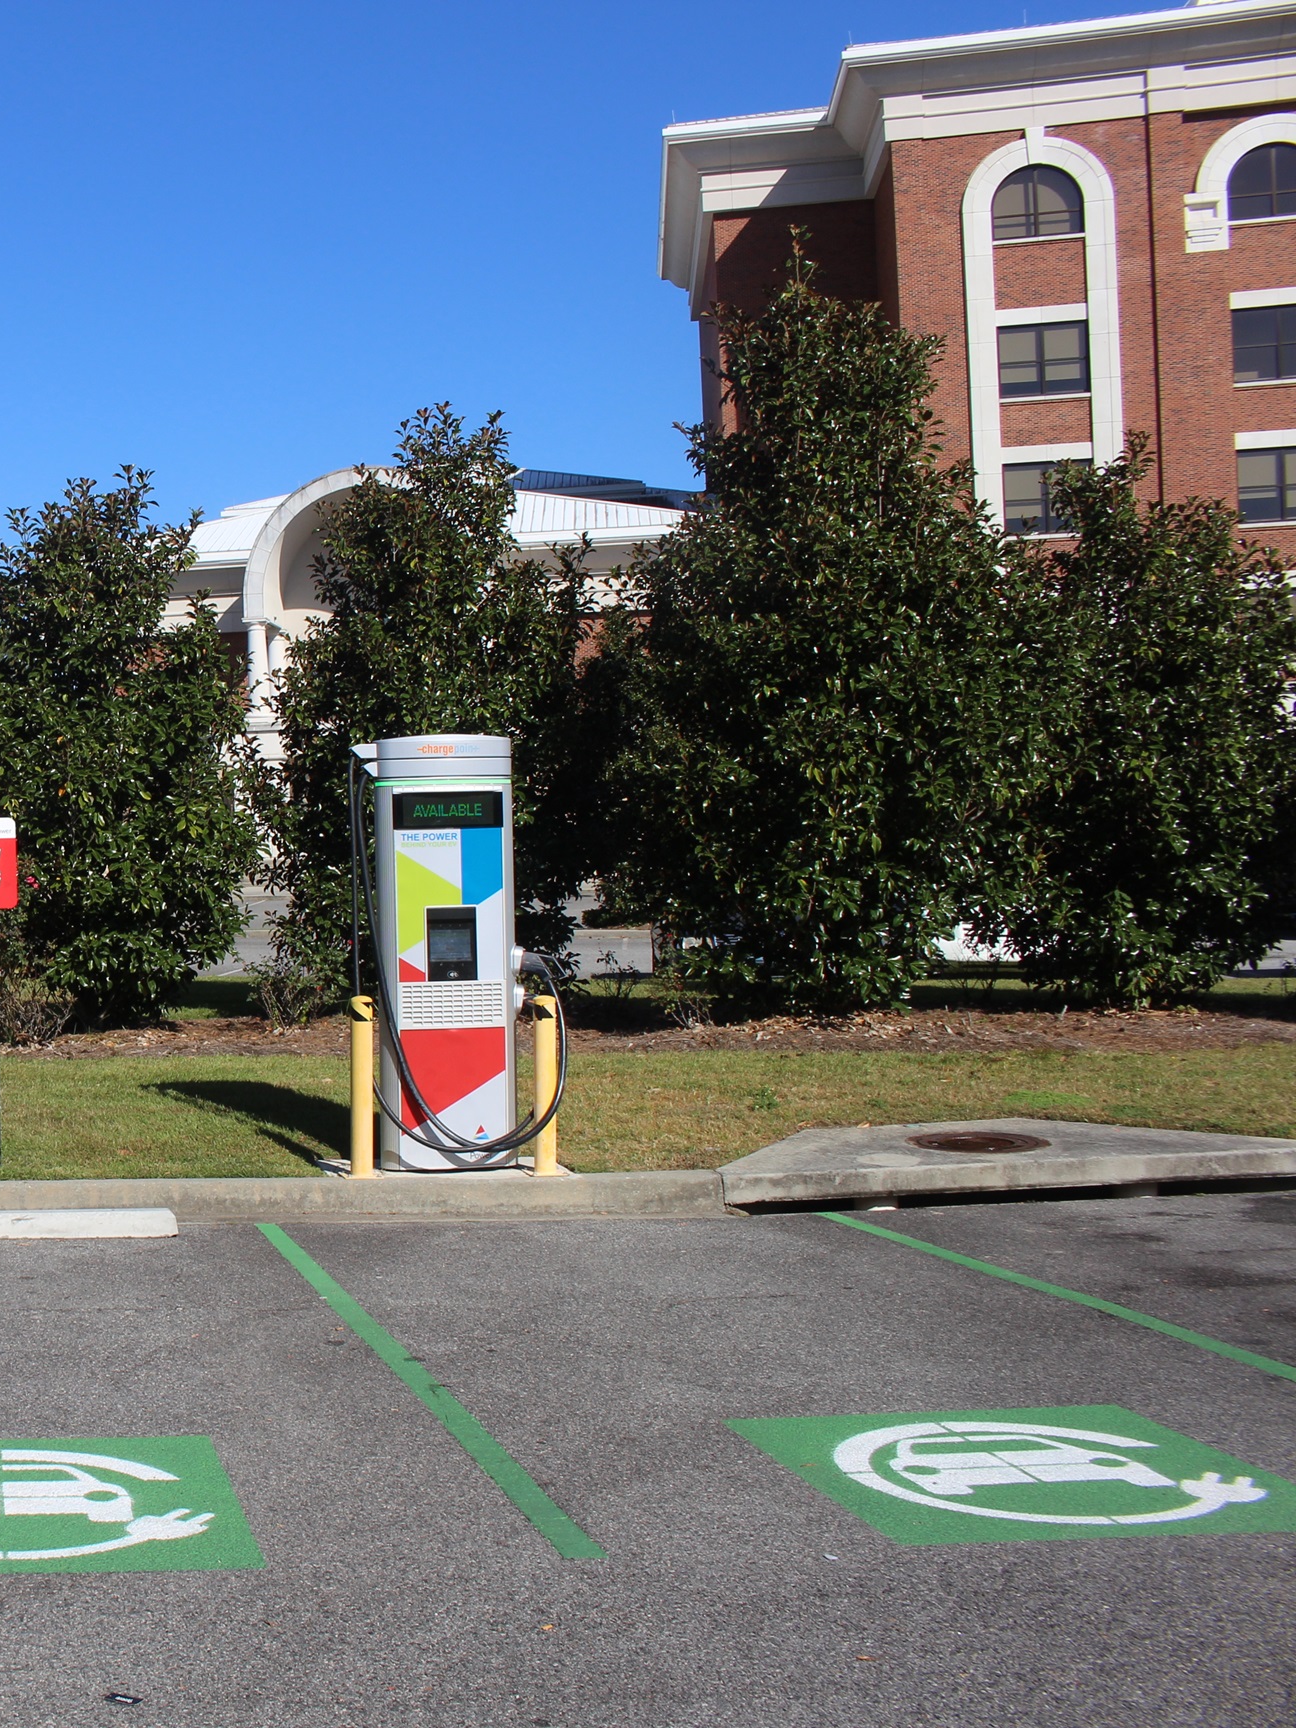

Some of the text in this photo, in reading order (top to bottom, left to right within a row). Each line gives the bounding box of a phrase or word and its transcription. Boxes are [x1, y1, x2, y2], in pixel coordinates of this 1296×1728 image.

[413, 803, 482, 817] AVAILABLE
[401, 832, 458, 841] THE POWER
